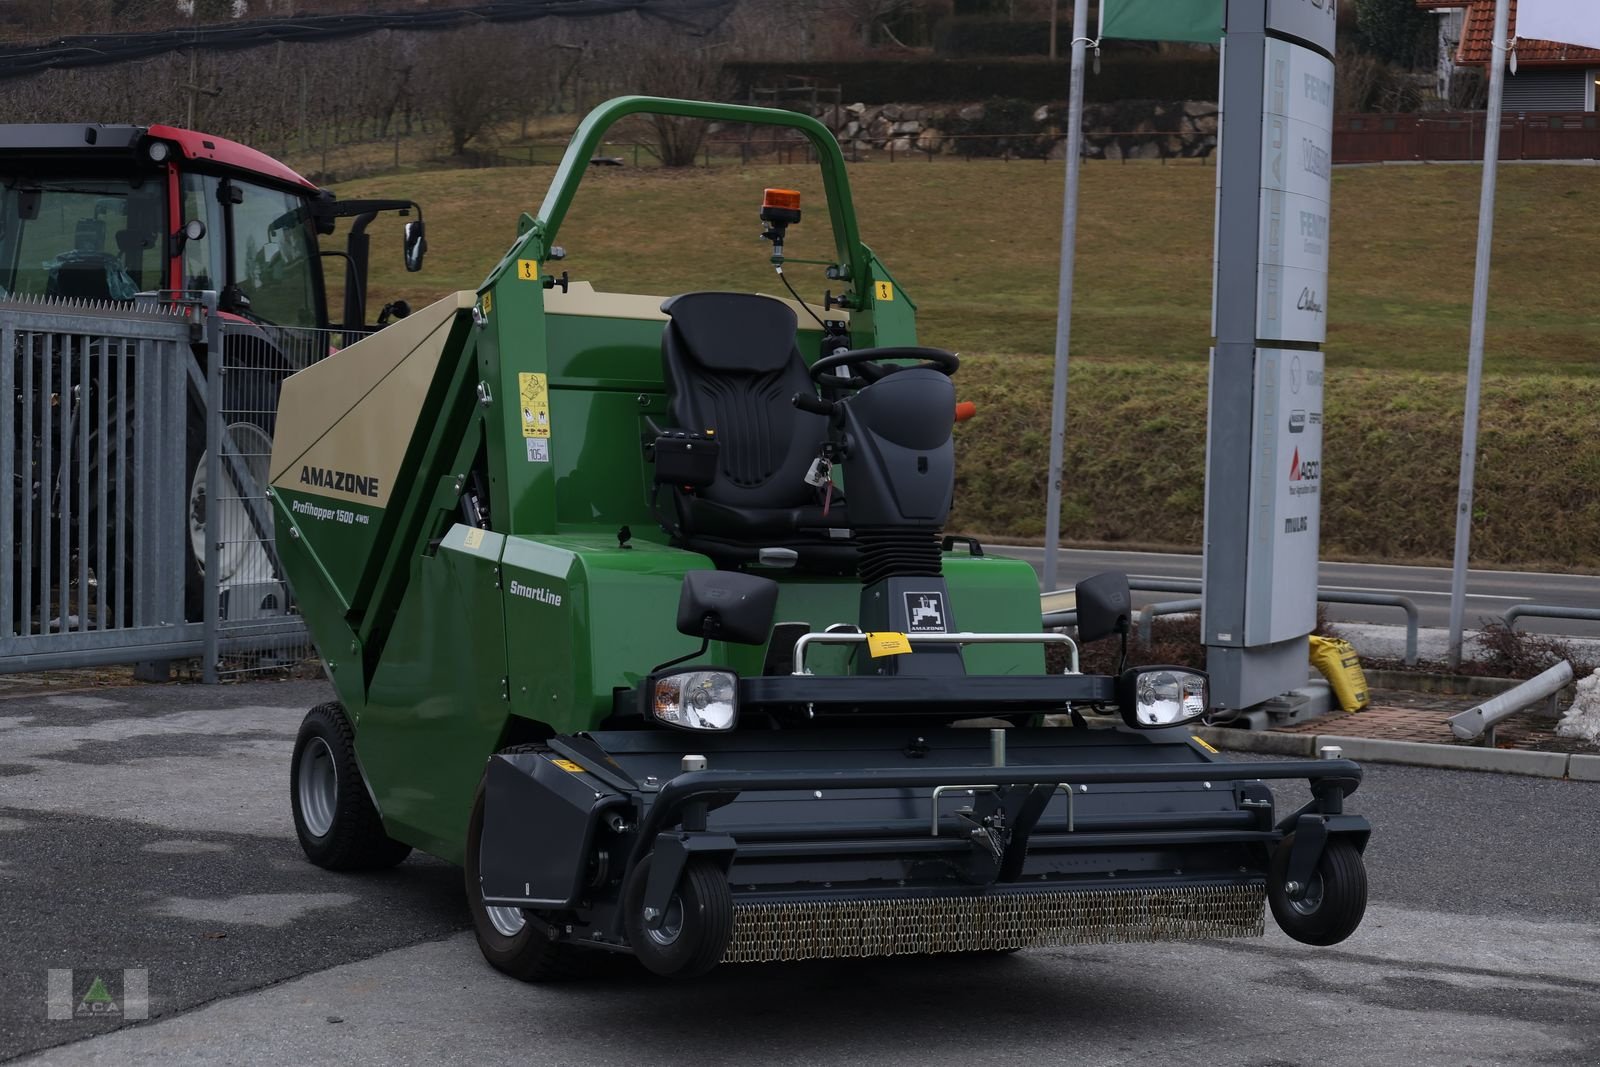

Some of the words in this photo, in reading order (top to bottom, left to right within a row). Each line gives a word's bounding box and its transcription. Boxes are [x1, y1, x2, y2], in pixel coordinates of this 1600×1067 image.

[300, 465, 379, 498] AMAZONE
[1301, 461, 1319, 480] AGCO
[292, 500, 336, 520] Profihopper
[336, 509, 354, 524] 1500
[509, 580, 562, 607] SmartLine
